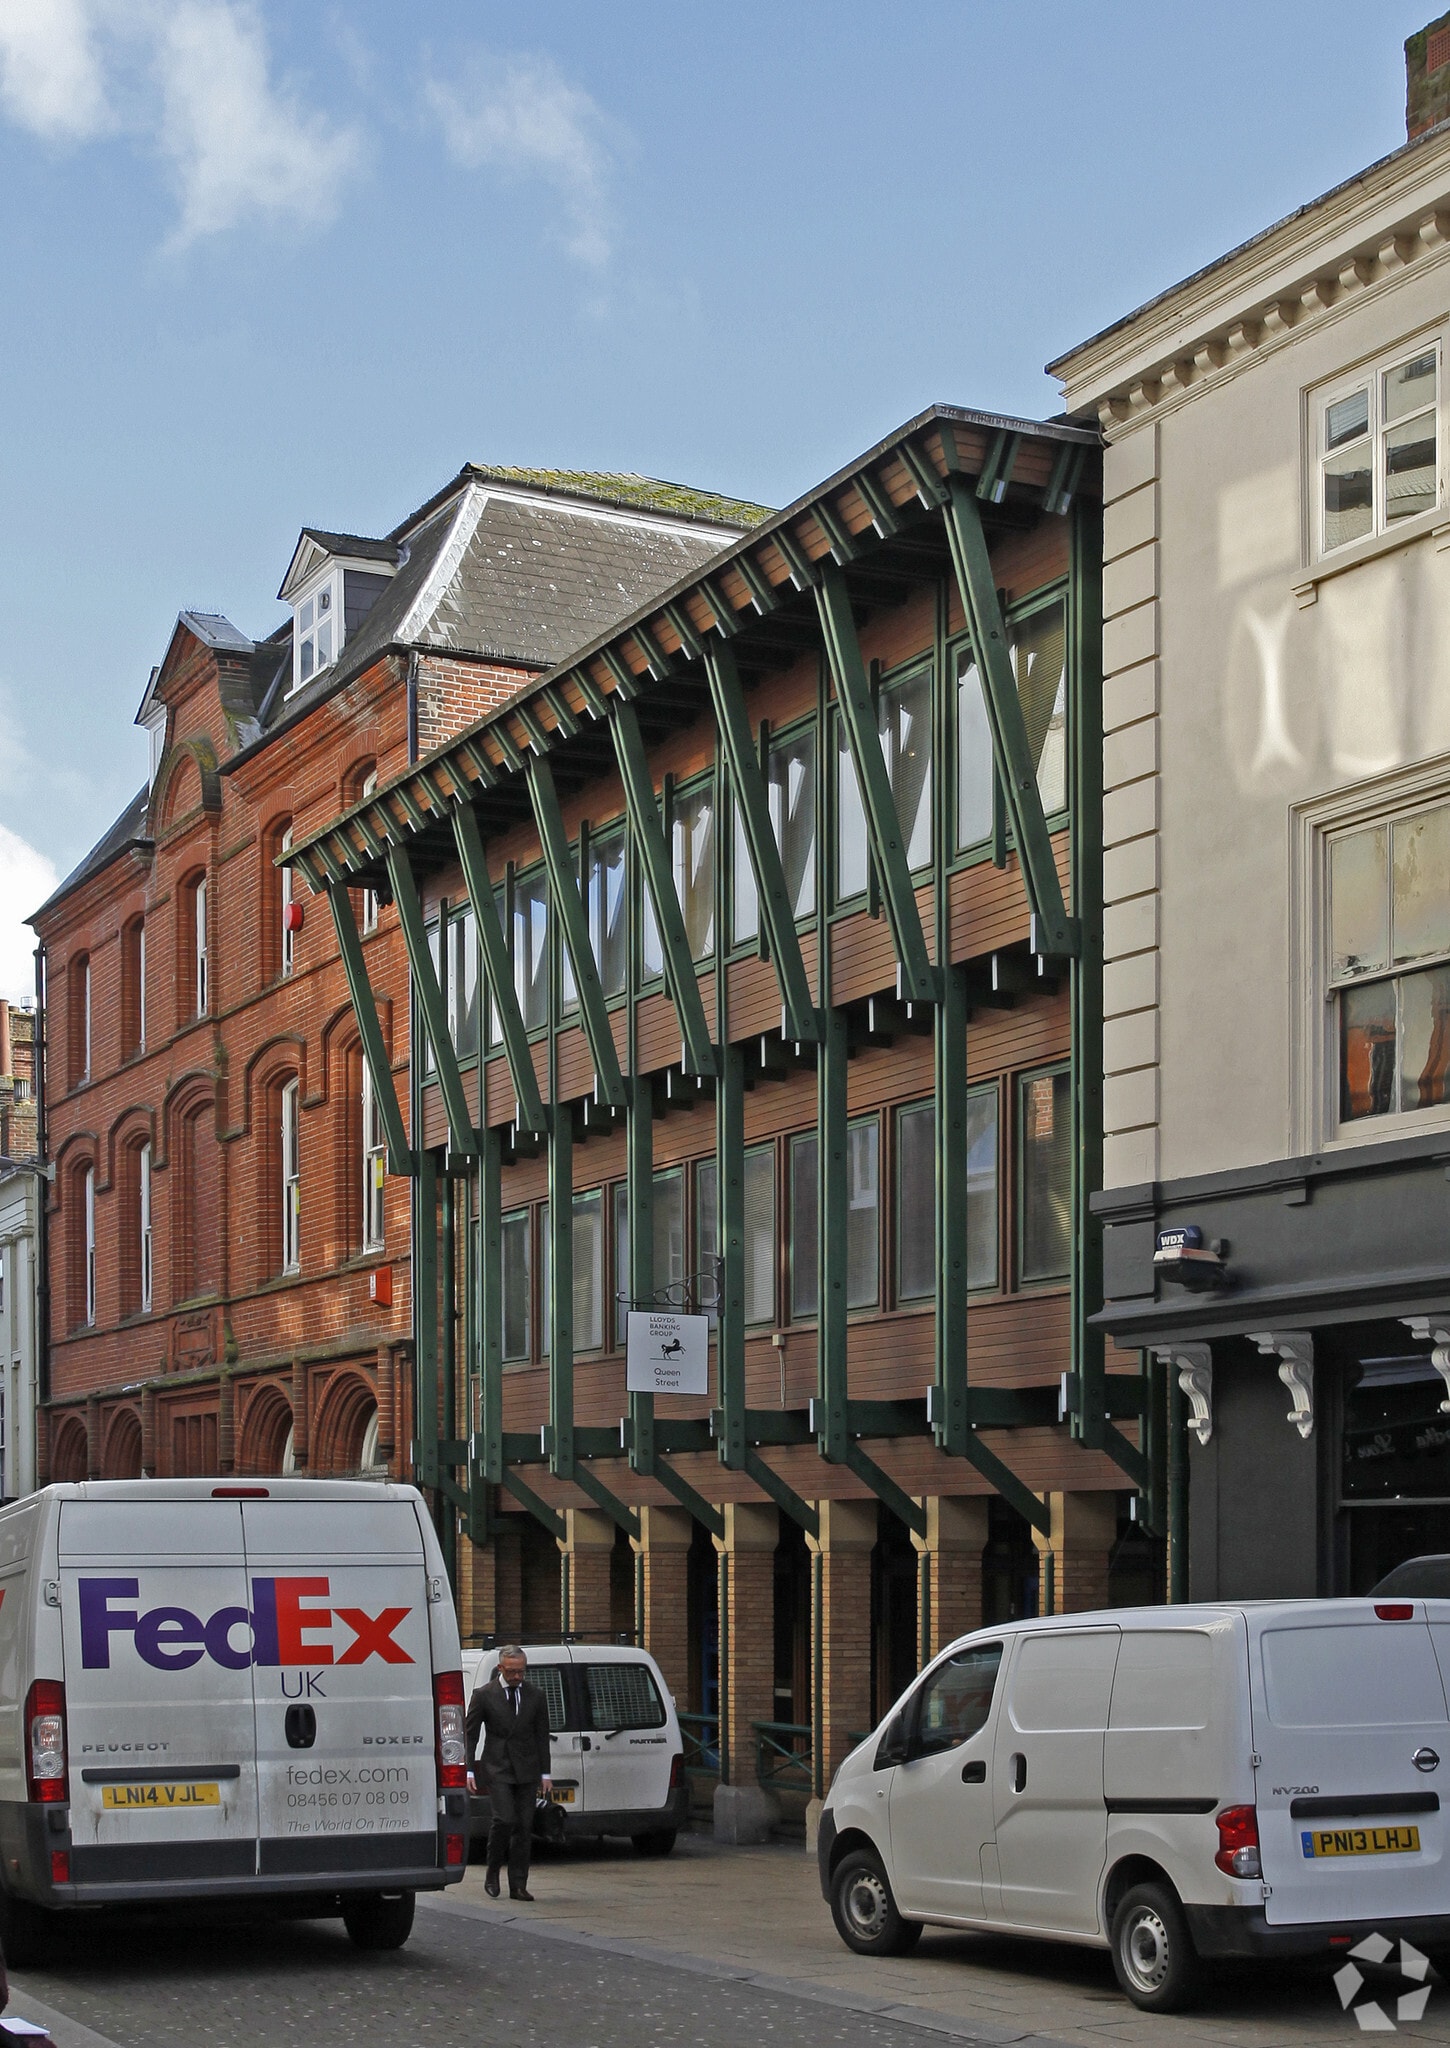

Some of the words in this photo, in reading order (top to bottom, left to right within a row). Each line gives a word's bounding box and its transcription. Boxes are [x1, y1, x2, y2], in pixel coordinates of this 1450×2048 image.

[1161, 1234, 1184, 1245] WDX
[654, 1367, 681, 1376] Queen
[655, 1378, 679, 1387] Street
[78, 1577, 416, 1671] FedEx
[280, 1671, 327, 1698] UK
[82, 1742, 170, 1753] PEUGEOT
[362, 1736, 424, 1745] BOXER
[286, 1765, 409, 1785] fedex.com
[112, 1786, 159, 1804] LN14
[164, 1785, 205, 1803] VJL
[287, 1793, 338, 1807] 08456
[342, 1792, 361, 1806] 07
[365, 1791, 385, 1805] 08
[389, 1790, 409, 1804] 09
[1272, 1785, 1320, 1796] NV200
[287, 1821, 310, 1832] The
[314, 1819, 352, 1831] World
[355, 1817, 374, 1829] On
[378, 1816, 410, 1828] Time
[1320, 1831, 1367, 1852] PN13
[1373, 1829, 1413, 1850] LHJ
